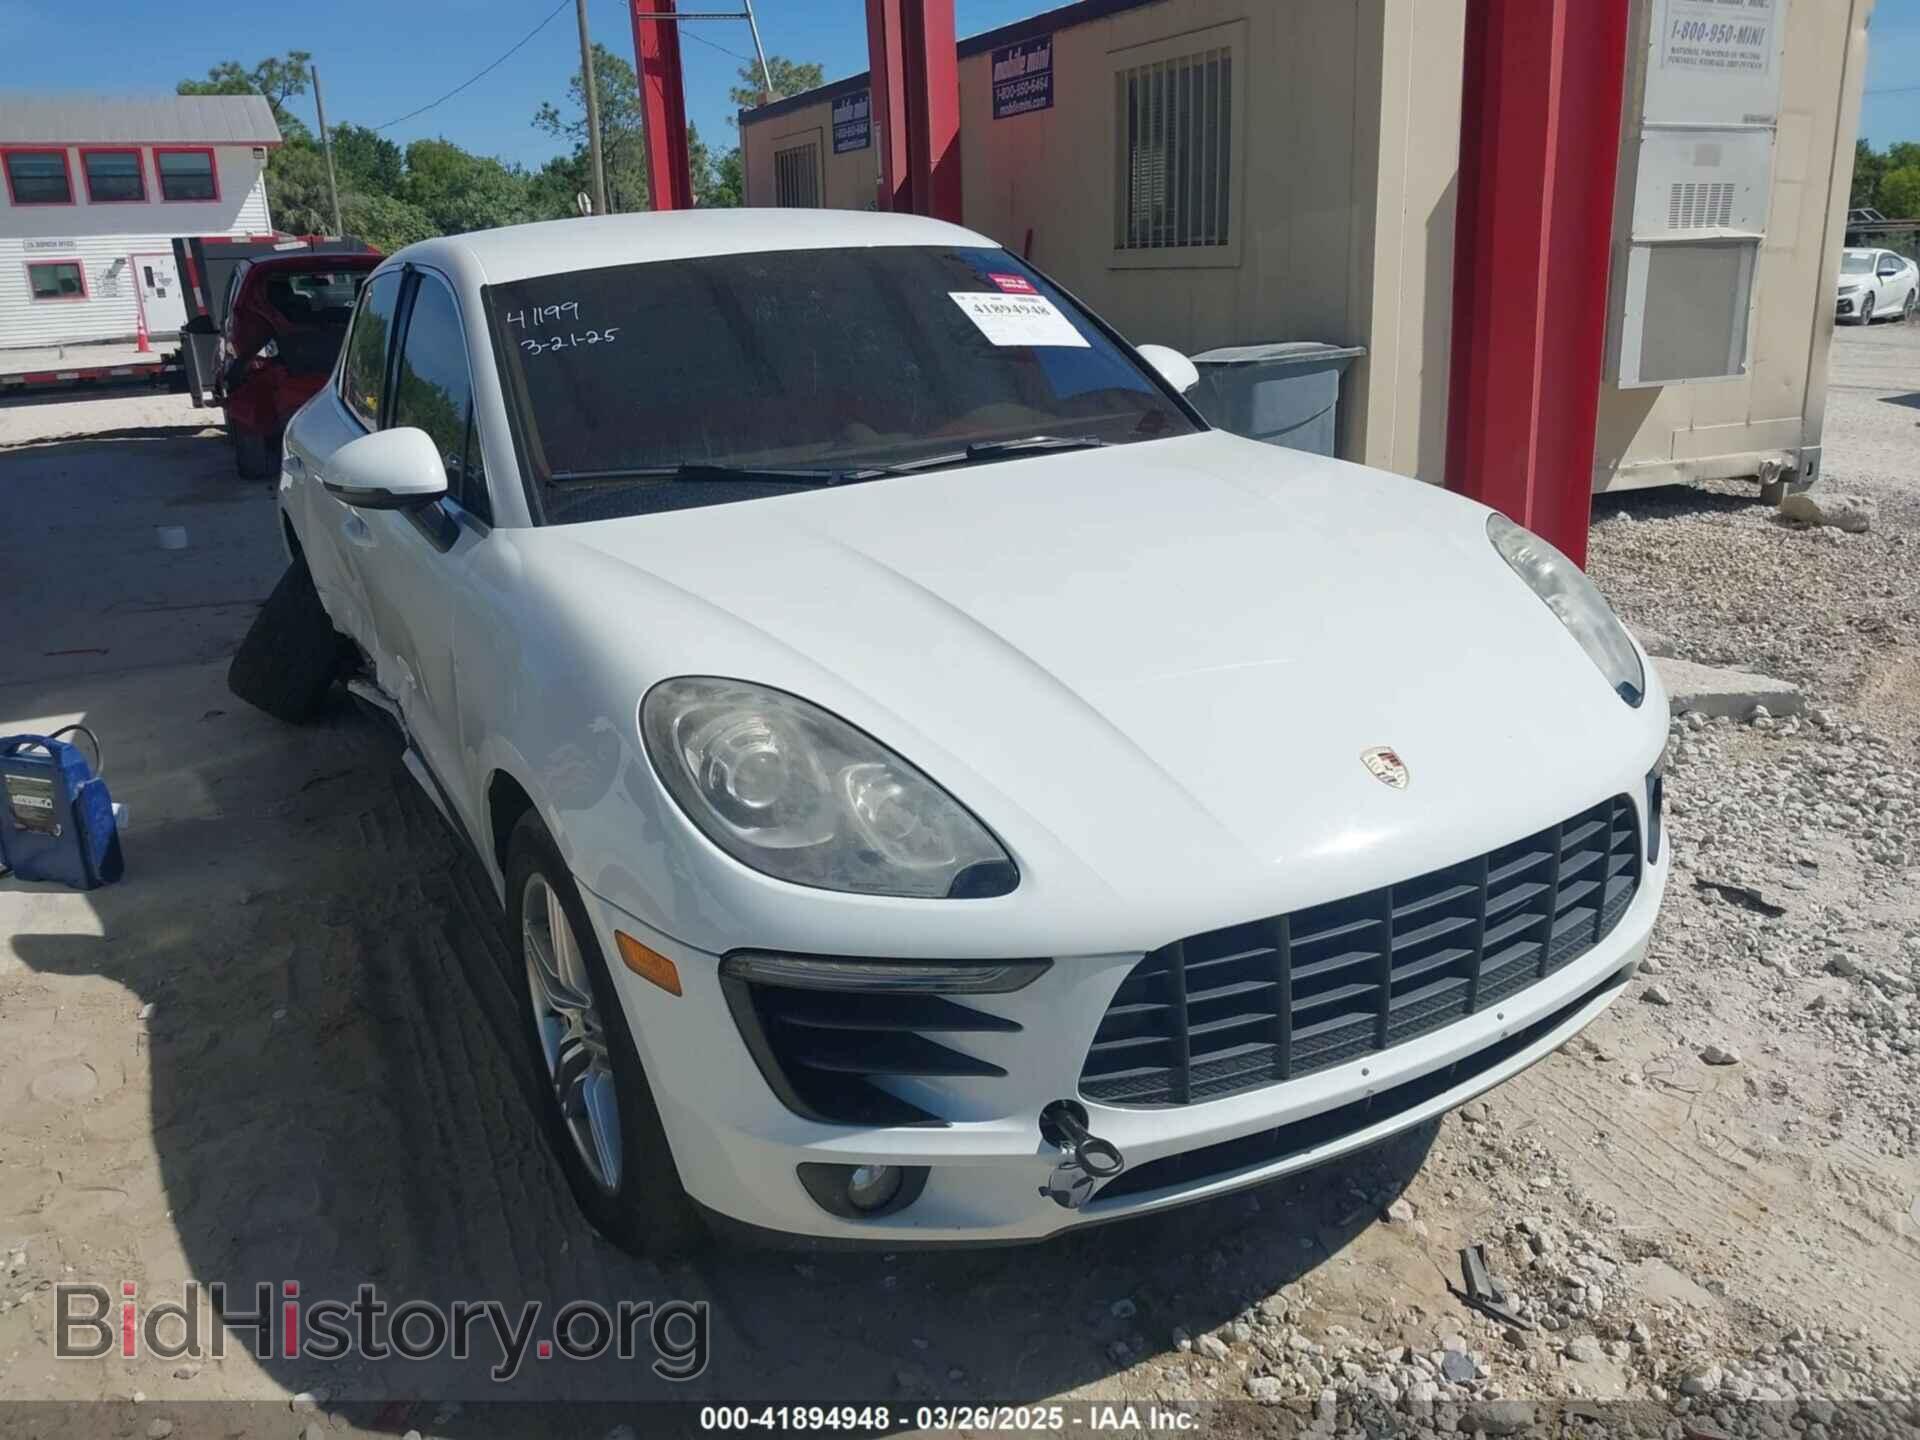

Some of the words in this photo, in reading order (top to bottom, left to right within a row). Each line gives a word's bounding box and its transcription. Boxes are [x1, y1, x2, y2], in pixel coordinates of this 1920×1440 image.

[1027, 42, 1050, 72] mini
[507, 301, 579, 329] 41199
[973, 303, 1051, 316] 41894948
[520, 327, 620, 355] 3-21-25
